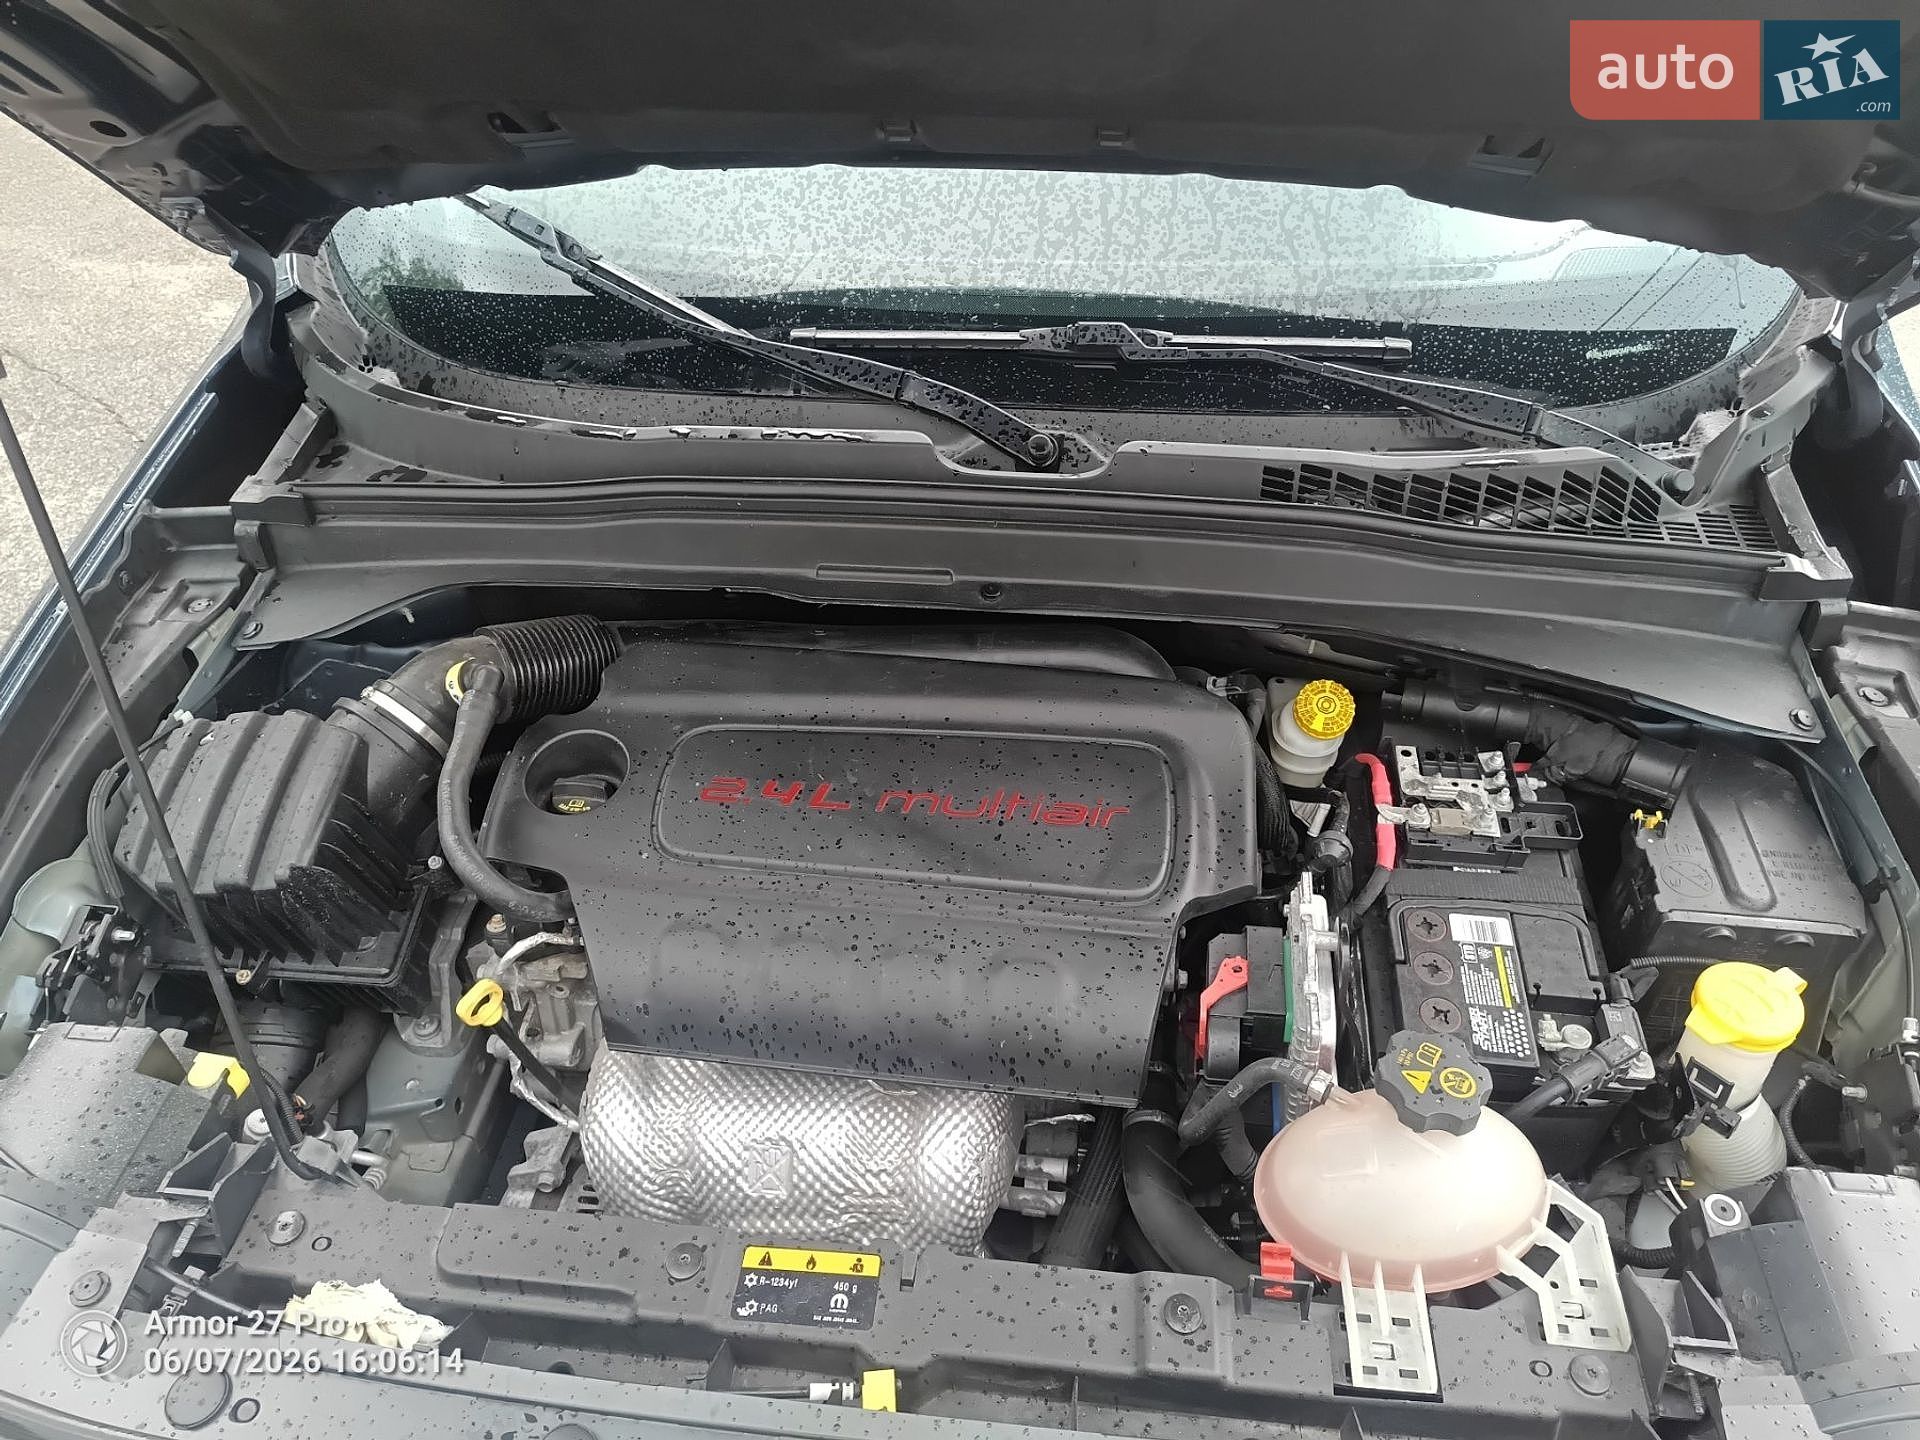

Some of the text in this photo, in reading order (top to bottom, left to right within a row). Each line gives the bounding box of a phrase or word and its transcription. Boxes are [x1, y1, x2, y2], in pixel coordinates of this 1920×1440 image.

[700, 775, 1130, 829] 2.4L multiair
[760, 1303, 778, 1314] PAG
